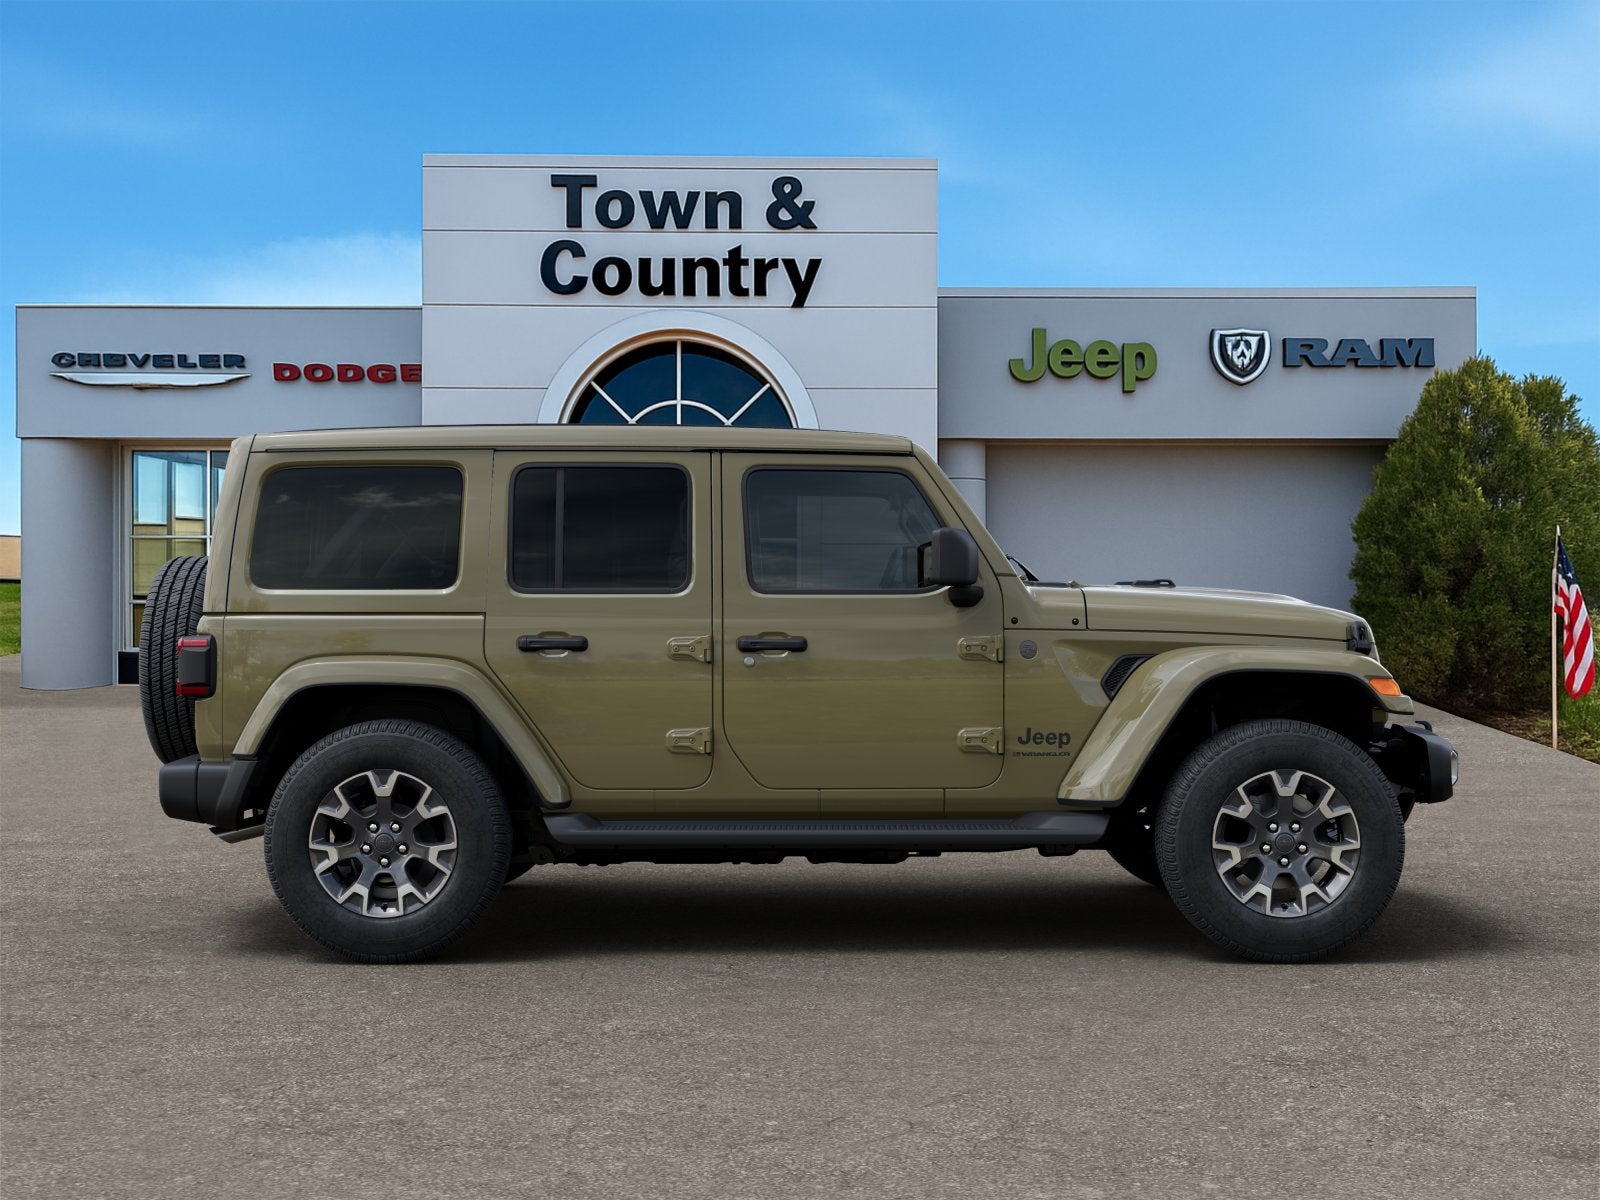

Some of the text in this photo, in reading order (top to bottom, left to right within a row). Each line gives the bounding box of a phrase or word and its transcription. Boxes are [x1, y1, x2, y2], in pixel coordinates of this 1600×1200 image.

[550, 174, 818, 230] Town &
[539, 239, 822, 308] Country
[273, 362, 422, 383] DODGE
[1009, 327, 1158, 393] Jeep
[1282, 337, 1435, 368] RAM
[1017, 727, 1071, 749] Jeep
